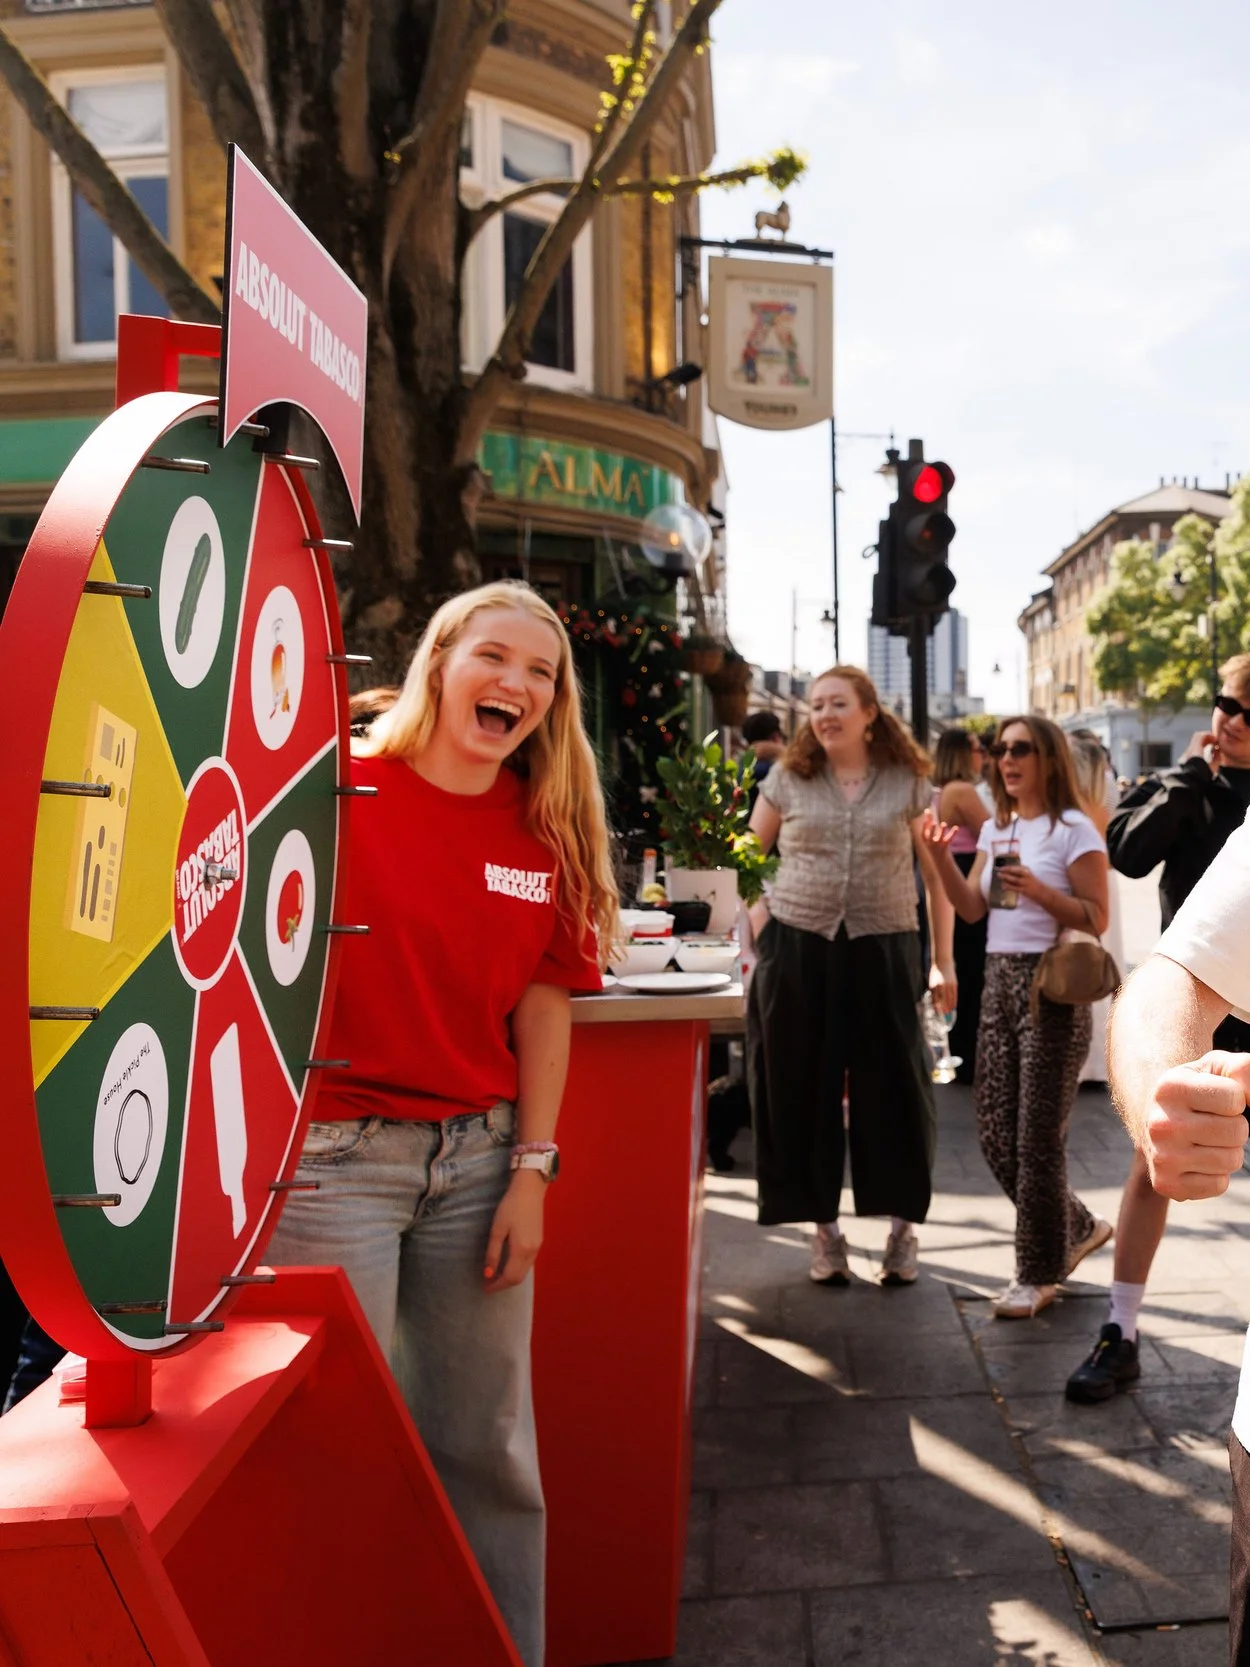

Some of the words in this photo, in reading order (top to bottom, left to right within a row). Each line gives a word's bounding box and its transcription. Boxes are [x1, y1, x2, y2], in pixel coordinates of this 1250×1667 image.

[235, 241, 306, 352] ABSOLUT
[310, 310, 360, 402] TABASCO
[529, 451, 646, 509] ALMA
[179, 808, 240, 901] TABASCO
[484, 862, 549, 889] ABSOLUT
[486, 878, 547, 904] TABASCO
[123, 1054, 140, 1081] Pickle
[104, 1078, 122, 1105] House
